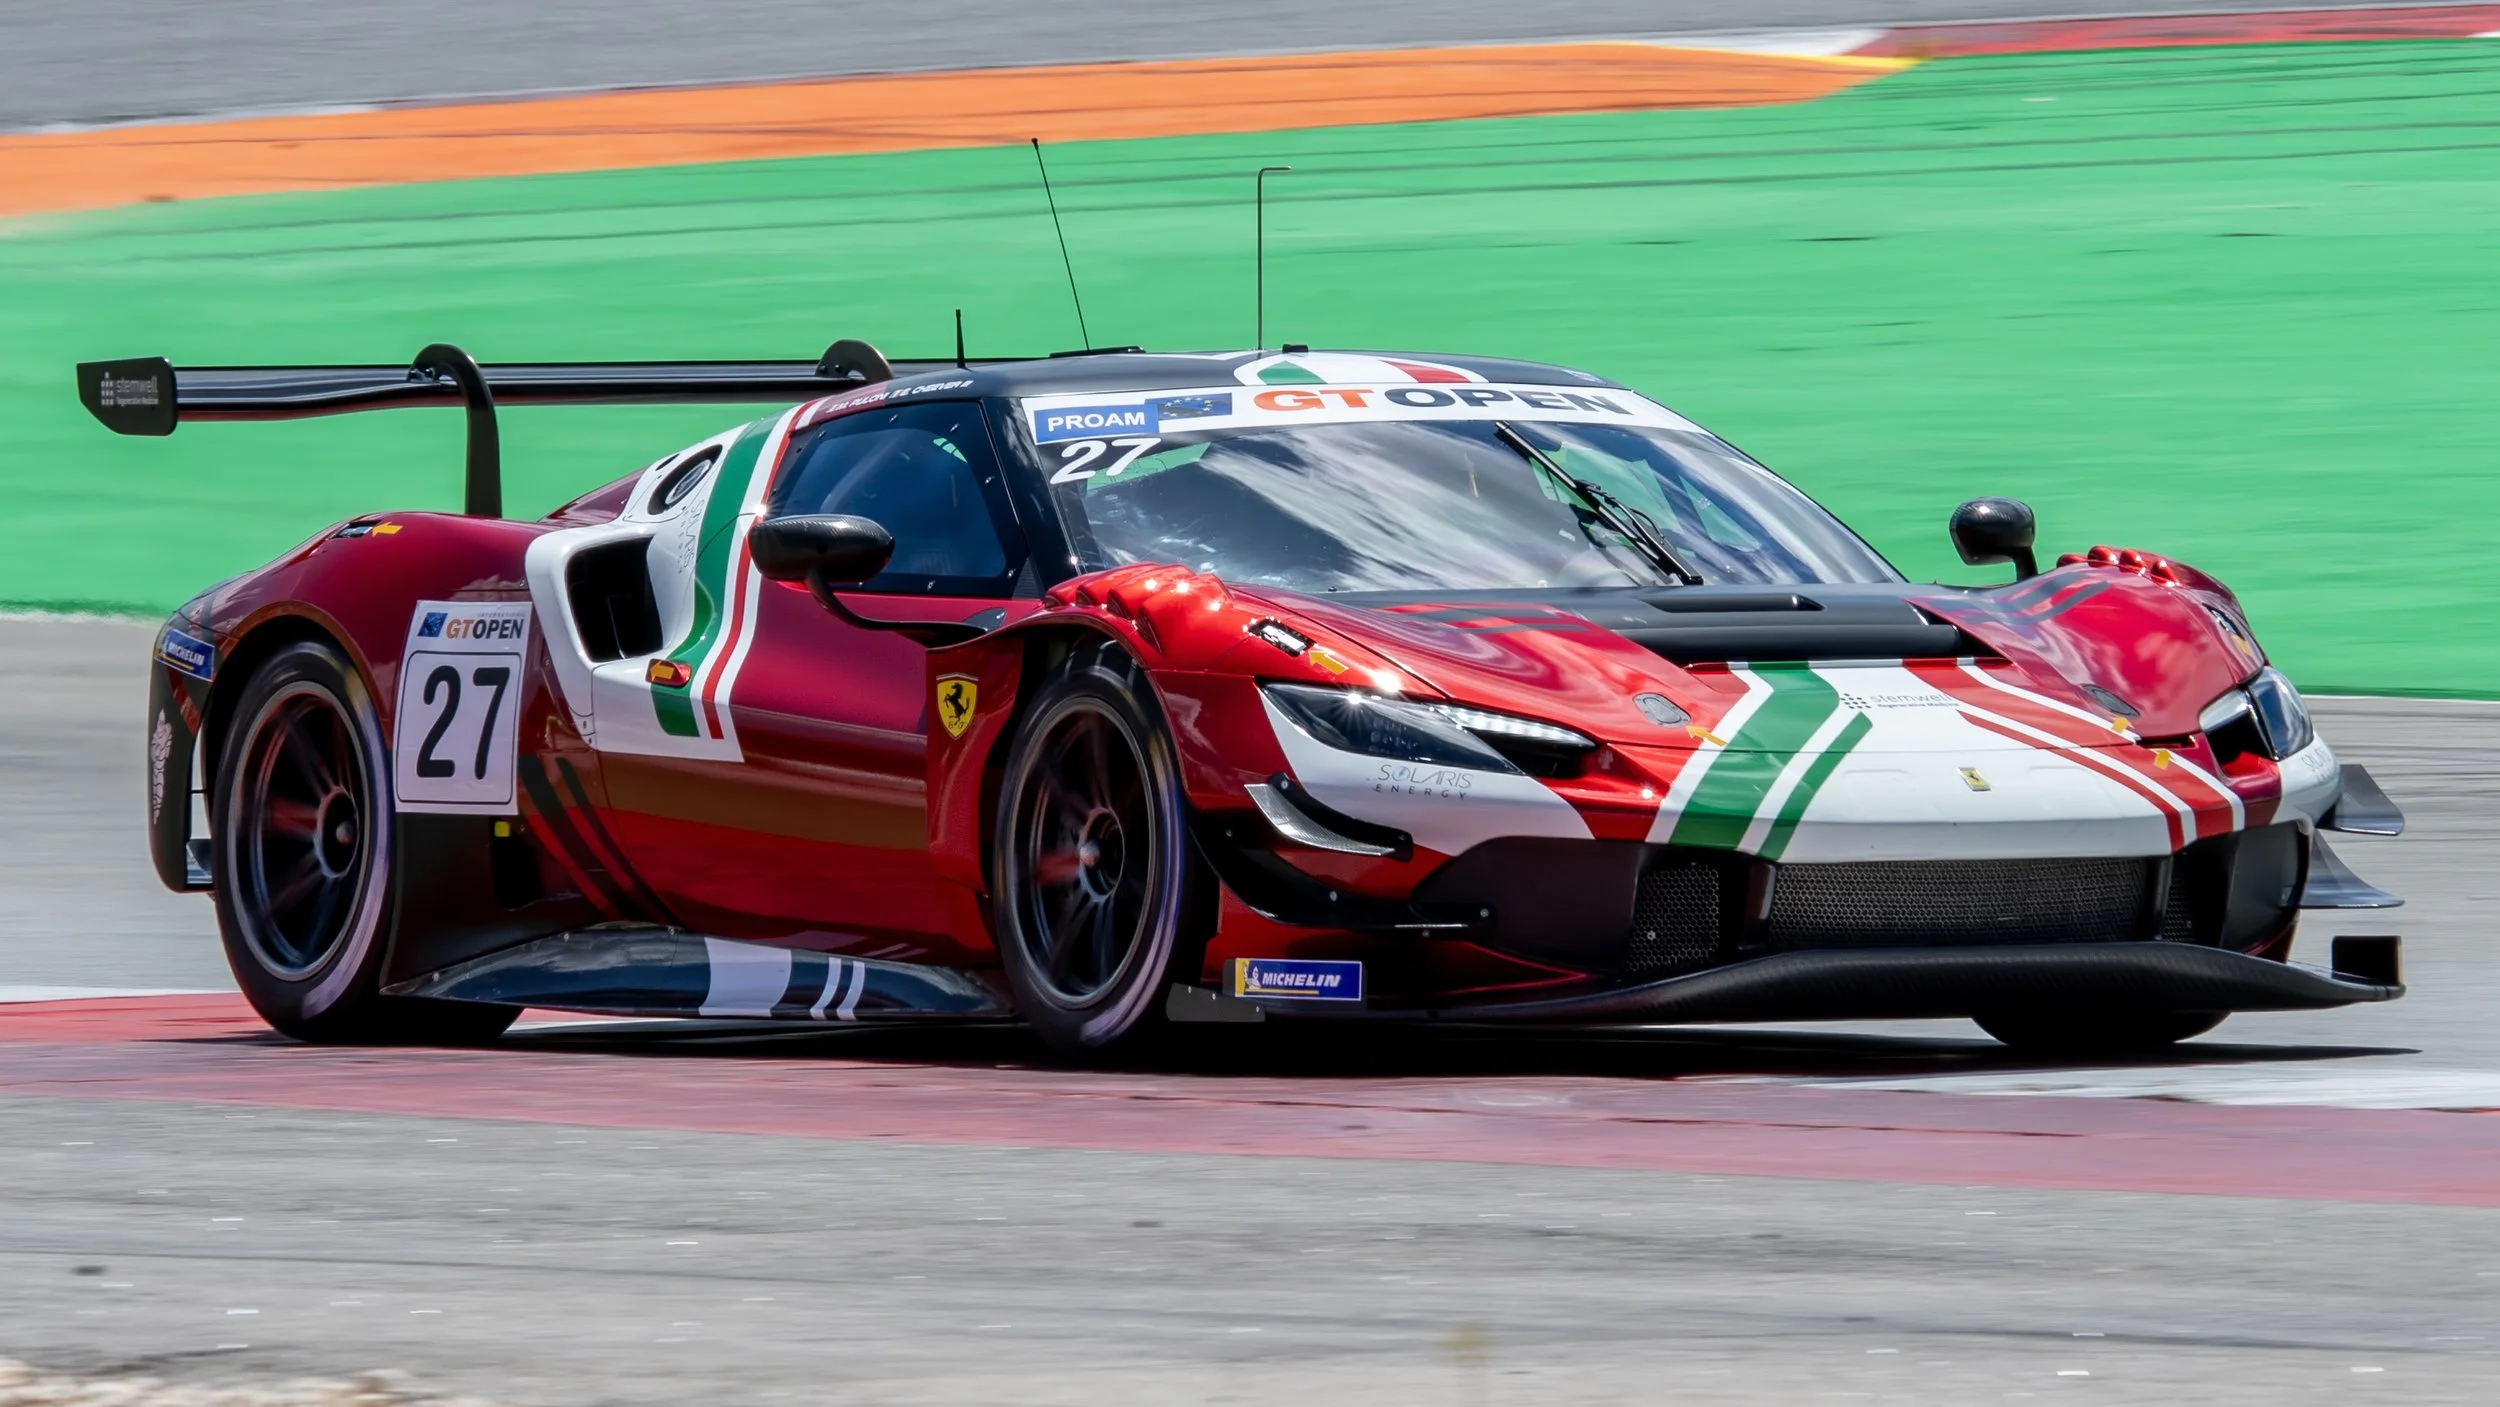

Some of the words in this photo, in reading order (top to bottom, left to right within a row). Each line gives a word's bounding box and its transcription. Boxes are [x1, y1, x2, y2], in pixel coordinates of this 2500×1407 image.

[116, 376, 158, 393] stemwell
[1048, 412, 1146, 432] PROAM
[1051, 438, 1162, 485] 27
[167, 642, 205, 666] MICHELIN
[1870, 693, 1953, 703] stemwell
[416, 665, 511, 780] 27
[1377, 764, 1474, 789] SOLARIS
[1375, 784, 1466, 800] ENERGY
[1262, 972, 1342, 988] MICHELIN
